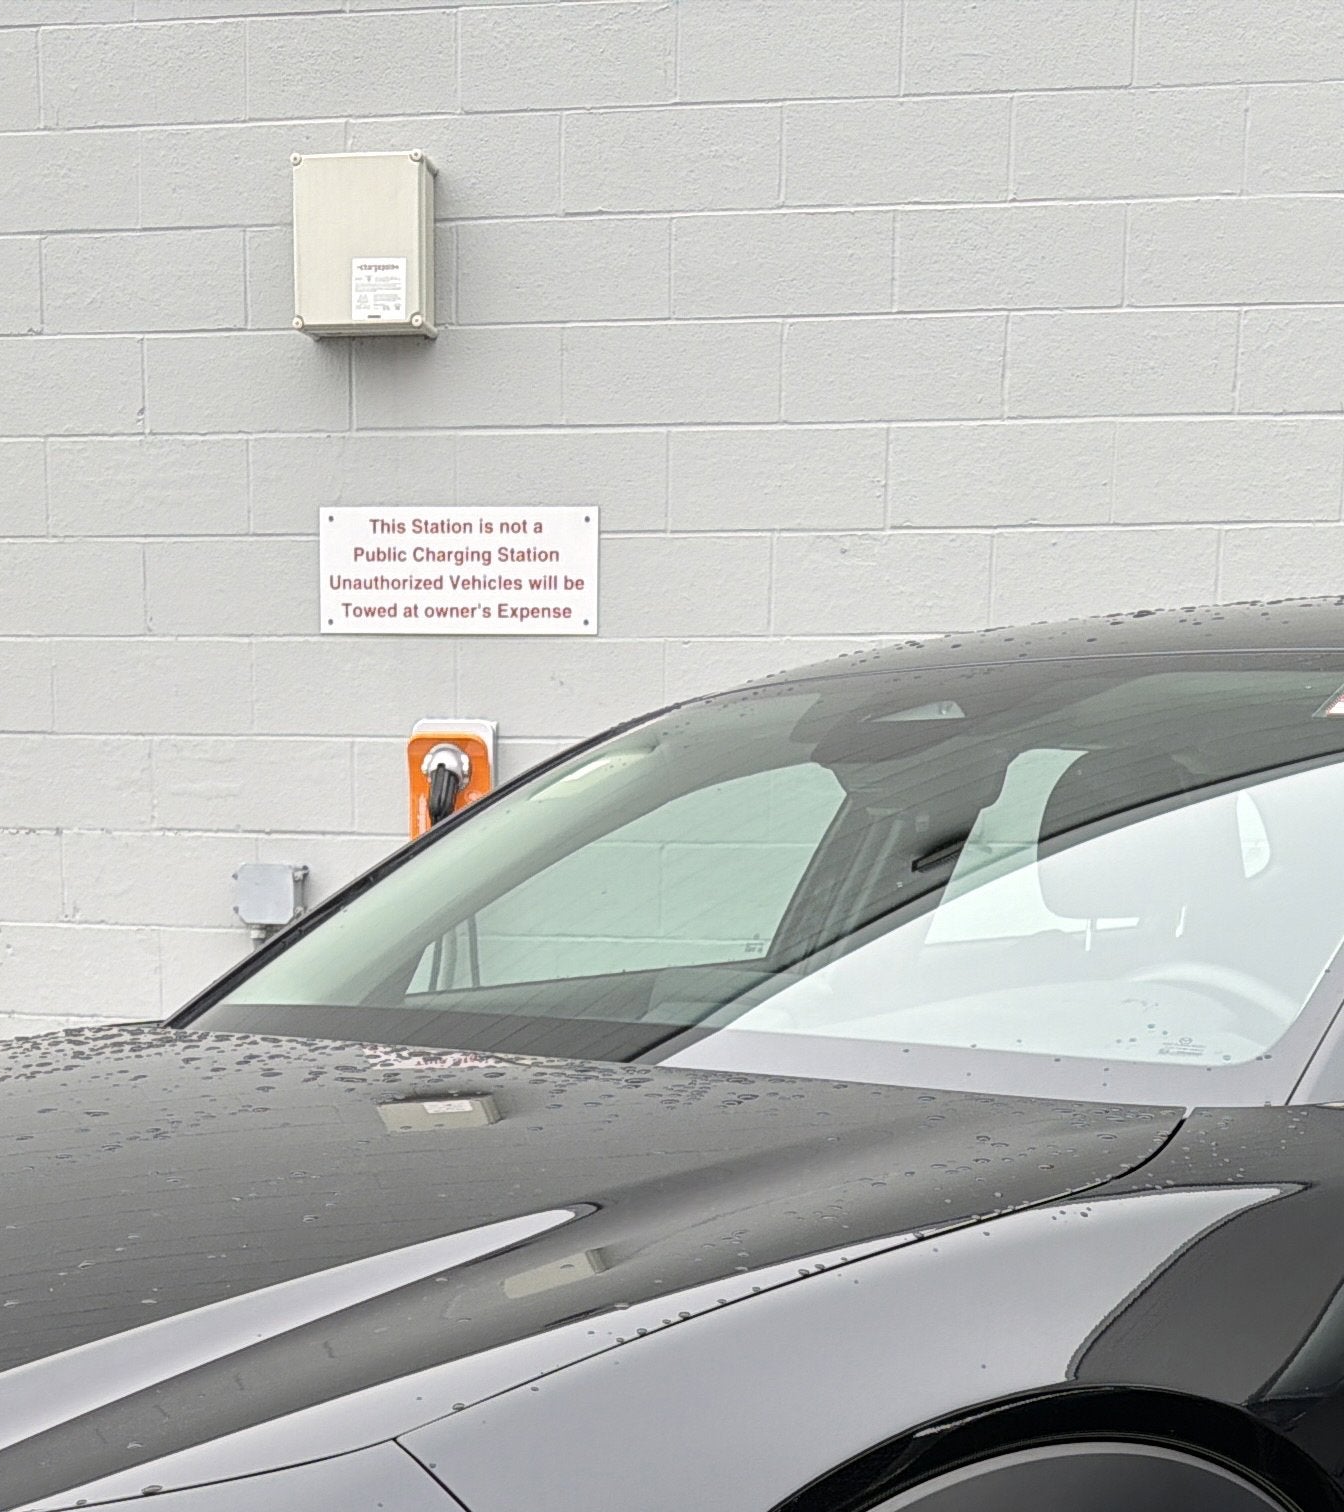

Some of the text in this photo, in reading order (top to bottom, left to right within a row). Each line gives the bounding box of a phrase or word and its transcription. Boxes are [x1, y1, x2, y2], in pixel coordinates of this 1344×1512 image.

[369, 518, 543, 535] This Station is not a
[353, 547, 559, 566] Public Charging Station
[329, 575, 584, 591] Unauthorized Vehicles will be
[341, 602, 572, 622] Towed at owner's Expense
